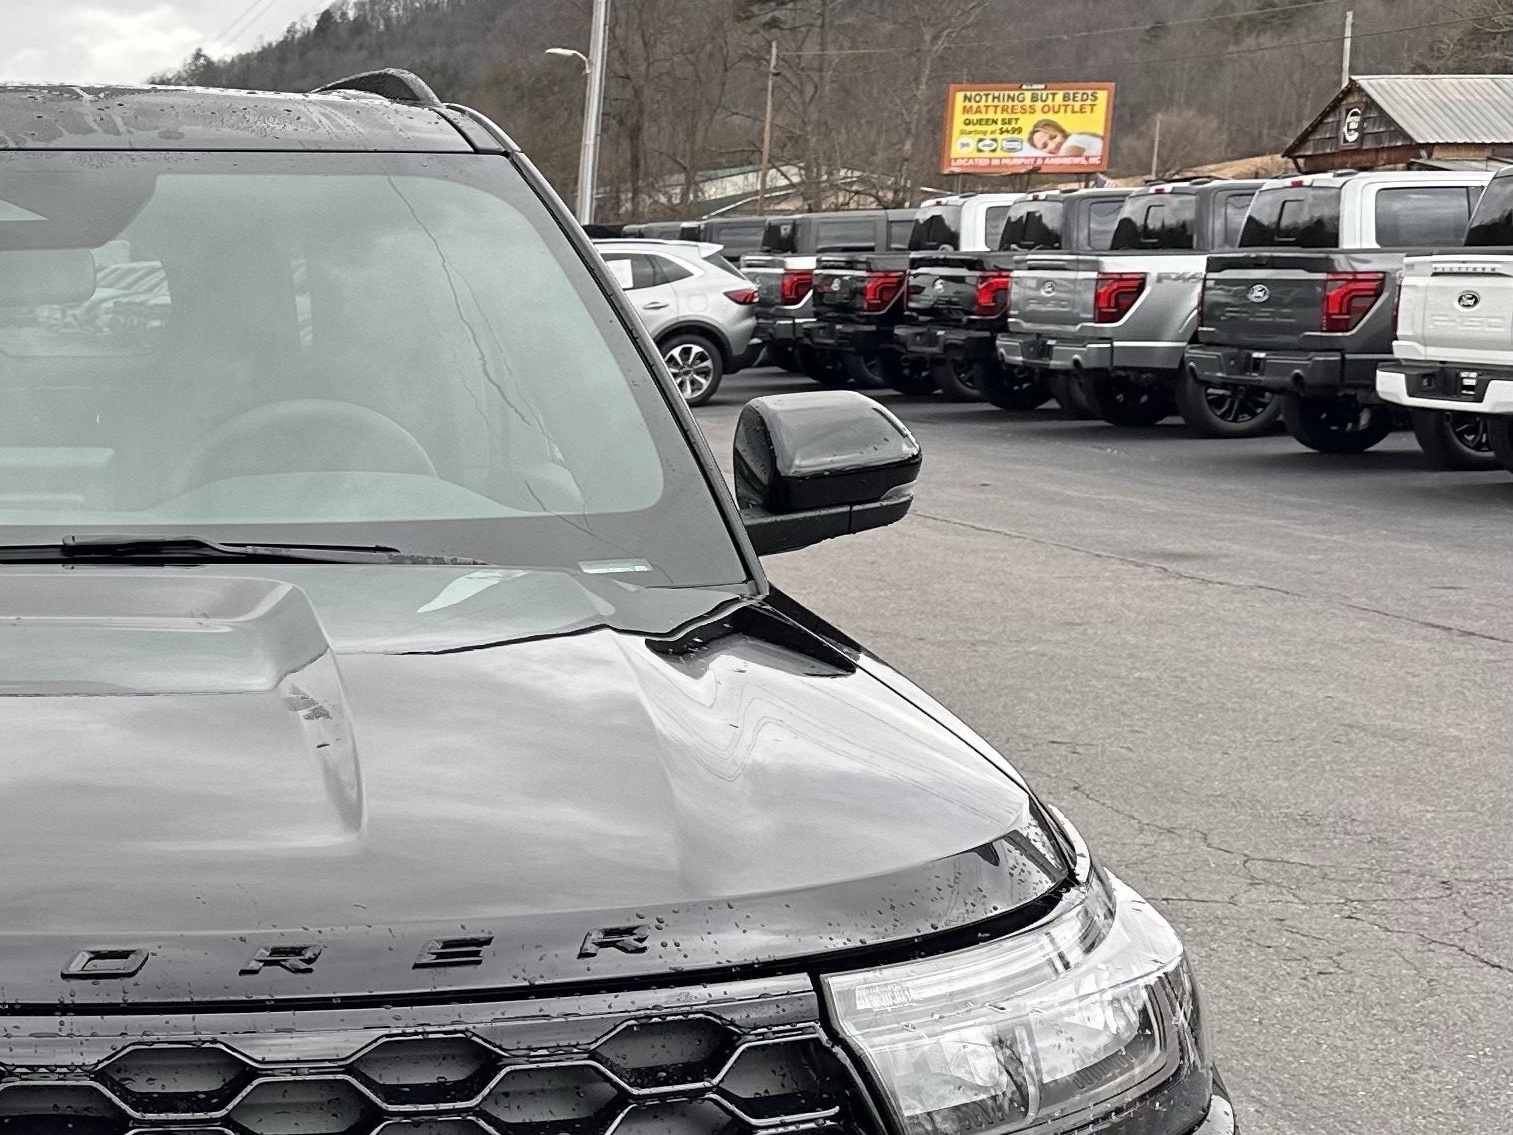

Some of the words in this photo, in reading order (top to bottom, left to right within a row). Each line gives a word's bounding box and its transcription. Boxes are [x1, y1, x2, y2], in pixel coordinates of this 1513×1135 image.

[962, 92, 1026, 103] NOTHING
[1030, 92, 1059, 103] BUT
[1062, 91, 1099, 102] BEDS
[961, 104, 1037, 115] MATTRESS
[1041, 103, 1097, 114] OUTLET
[963, 118, 998, 126] QUEEN
[1001, 117, 1020, 126] SET
[959, 128, 988, 136] Starting
[998, 126, 1023, 135] $499
[951, 157, 990, 167] LOCATED
